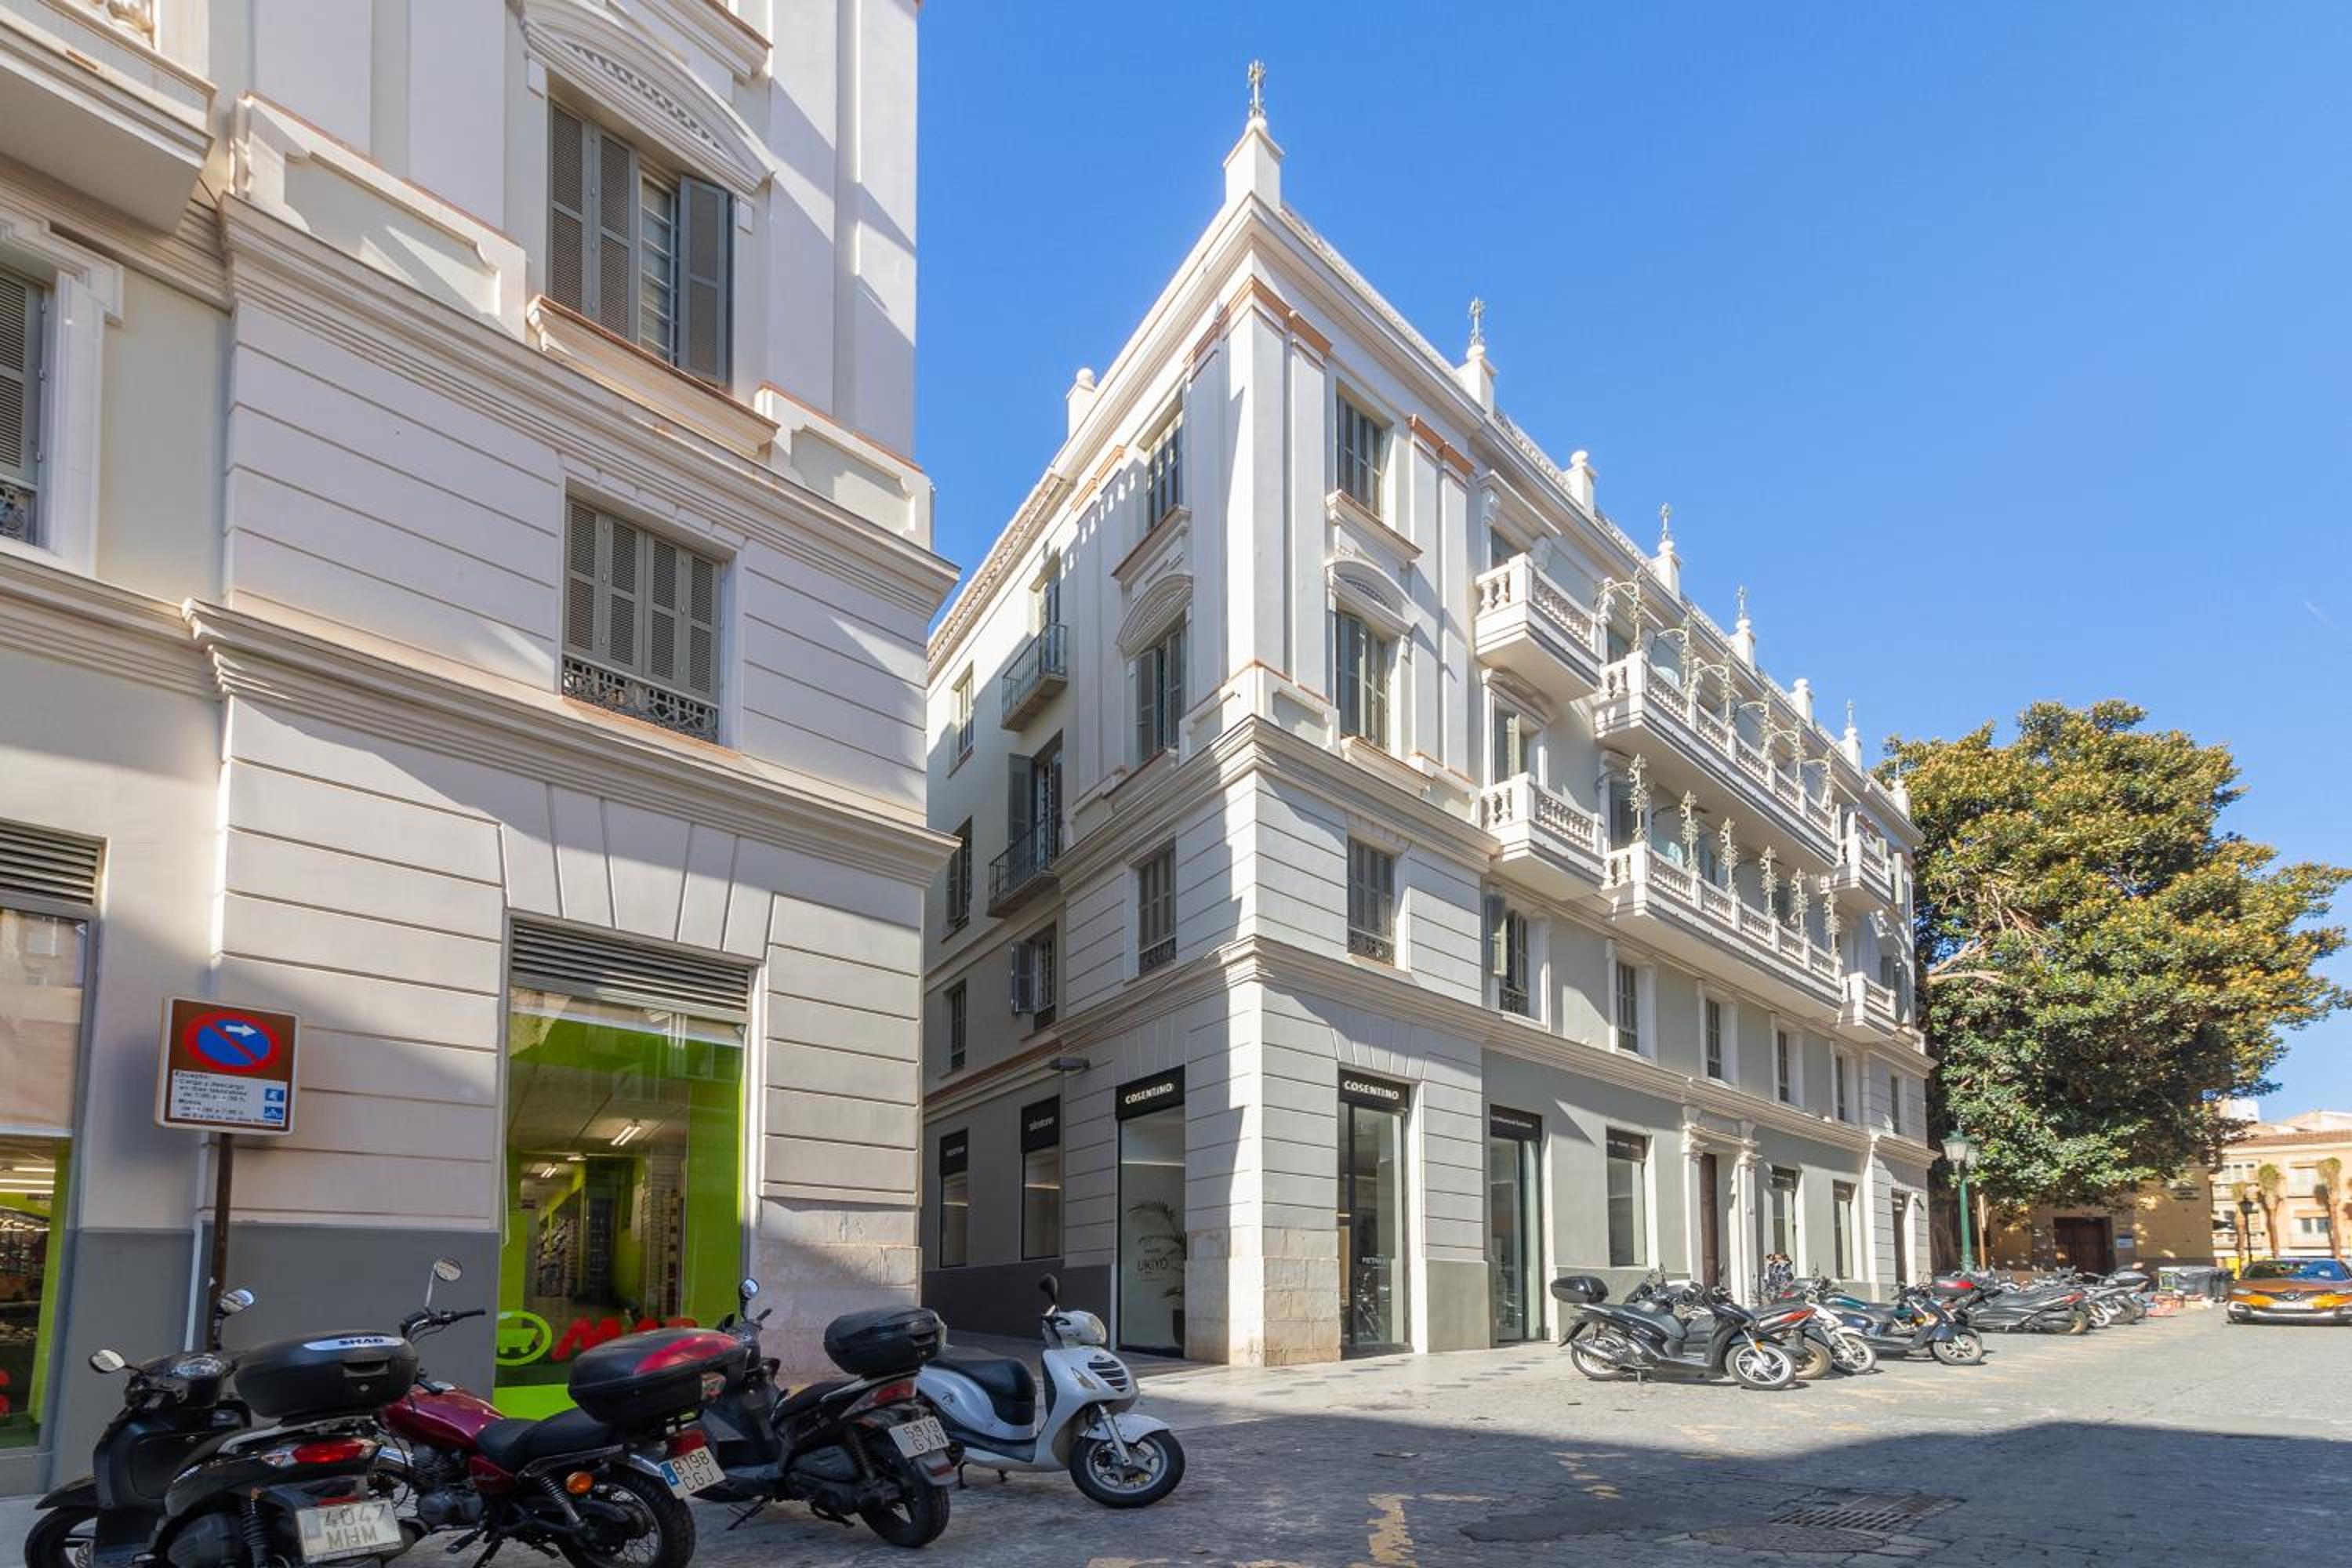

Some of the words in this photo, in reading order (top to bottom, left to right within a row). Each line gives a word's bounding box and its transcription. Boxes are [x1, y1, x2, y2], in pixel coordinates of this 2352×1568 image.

[1125, 1083, 1174, 1104] COSENTINO
[1344, 1080, 1399, 1100] COSENTINO
[673, 1451, 710, 1474] 8198
[683, 1467, 714, 1490] CGJ
[325, 1504, 386, 1527] 4047
